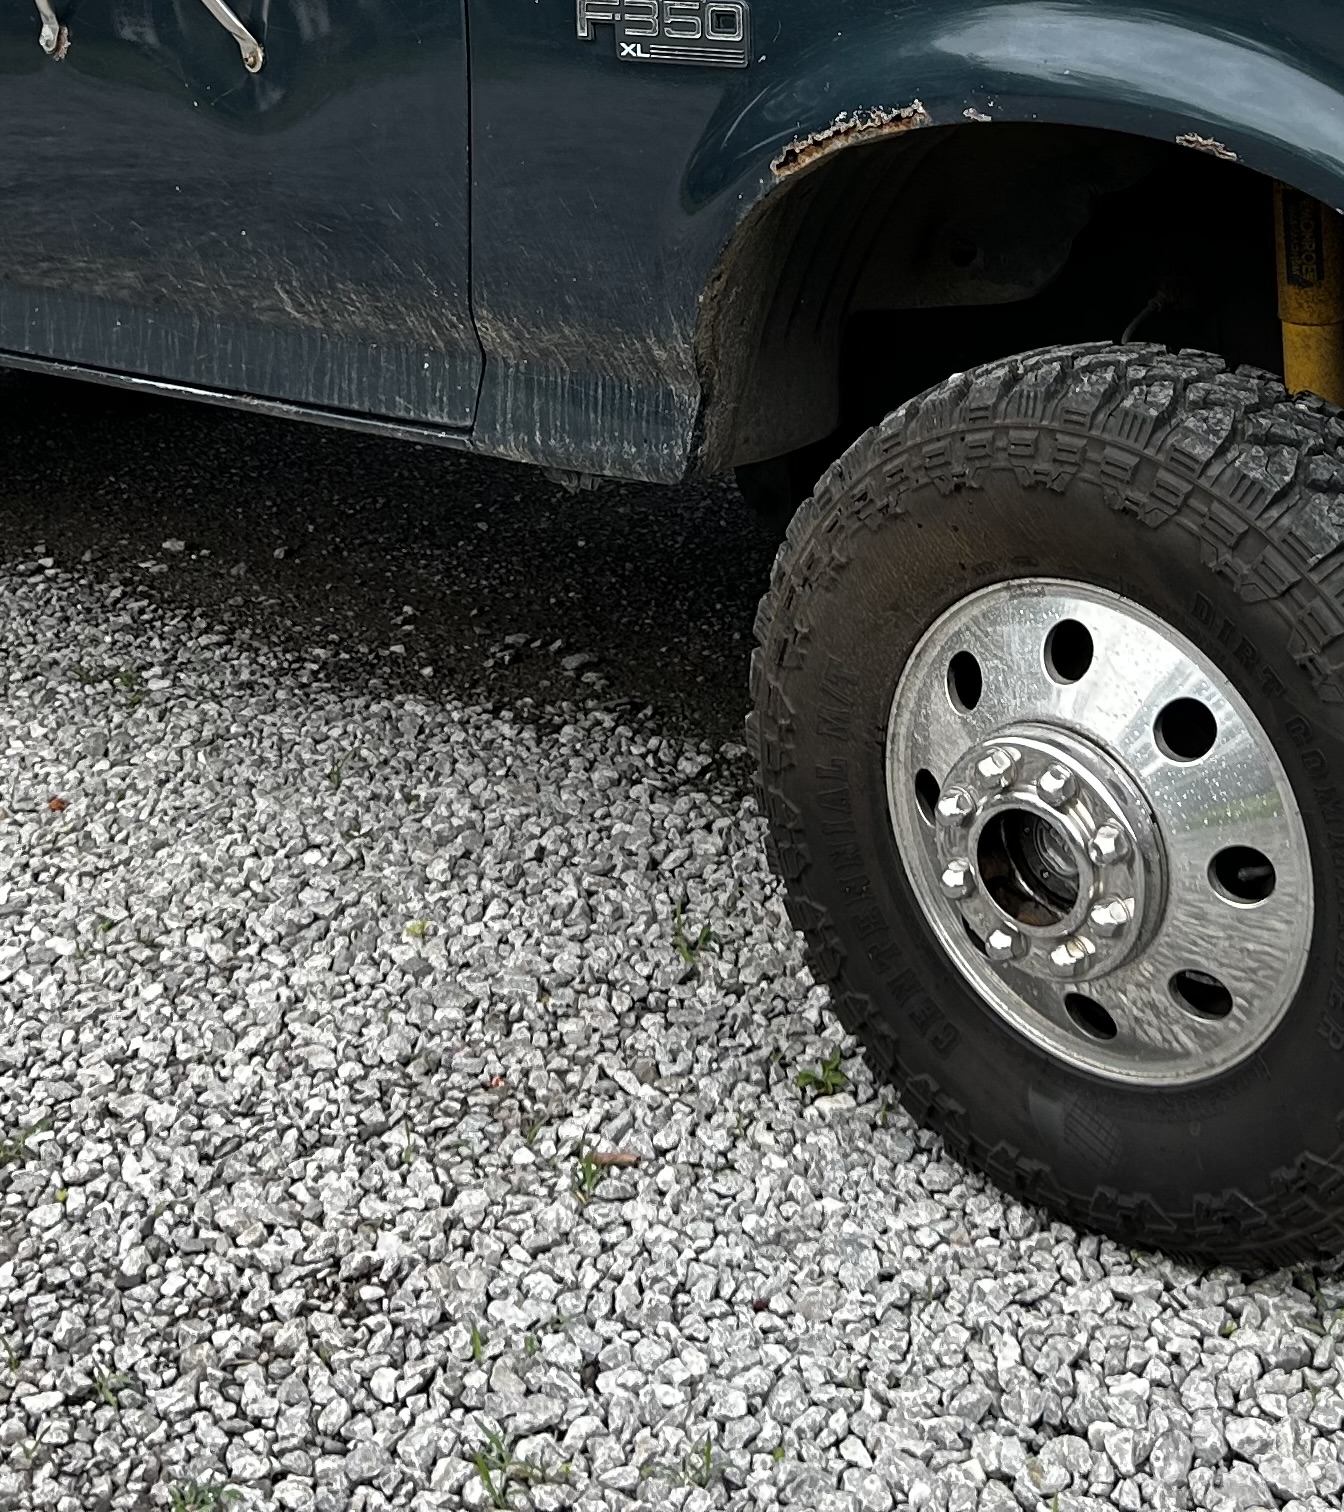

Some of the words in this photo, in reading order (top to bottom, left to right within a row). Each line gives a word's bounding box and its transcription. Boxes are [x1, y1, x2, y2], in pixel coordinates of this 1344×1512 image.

[619, 43, 650, 57] XL
[1191, 590, 1287, 700] DIRT
[815, 757, 962, 1060] CENTENNIAL
